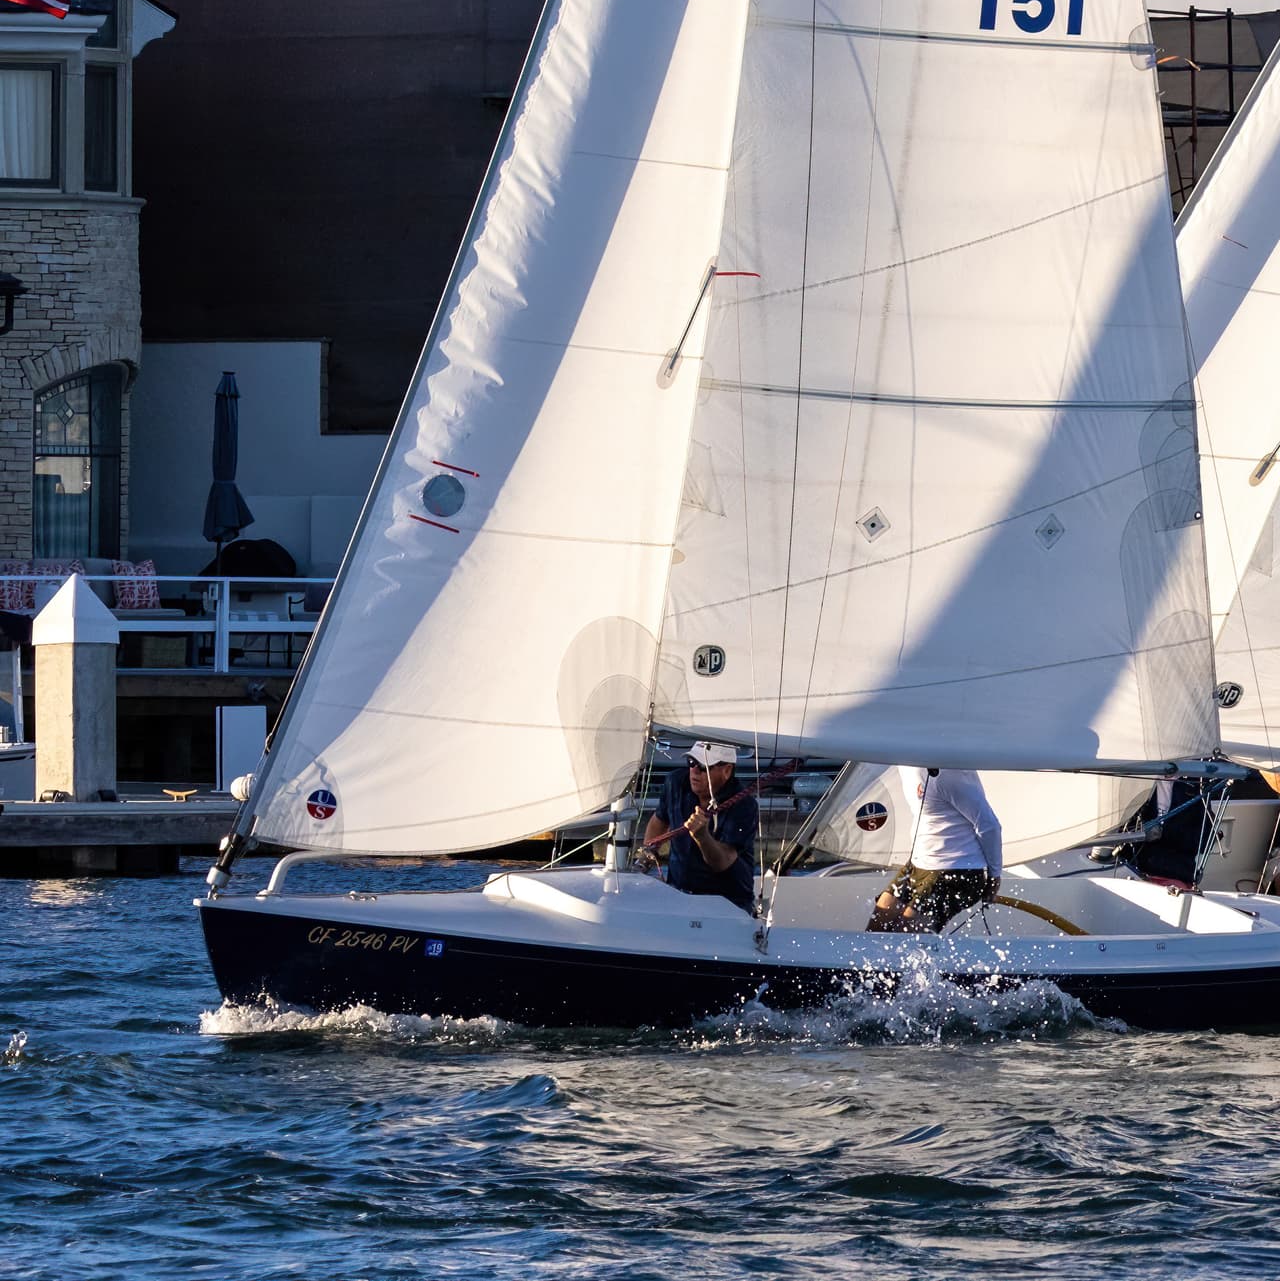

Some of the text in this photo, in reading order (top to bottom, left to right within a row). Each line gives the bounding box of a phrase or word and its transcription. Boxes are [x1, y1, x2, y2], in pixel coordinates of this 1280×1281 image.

[308, 926, 419, 953] CF 2546 PV
